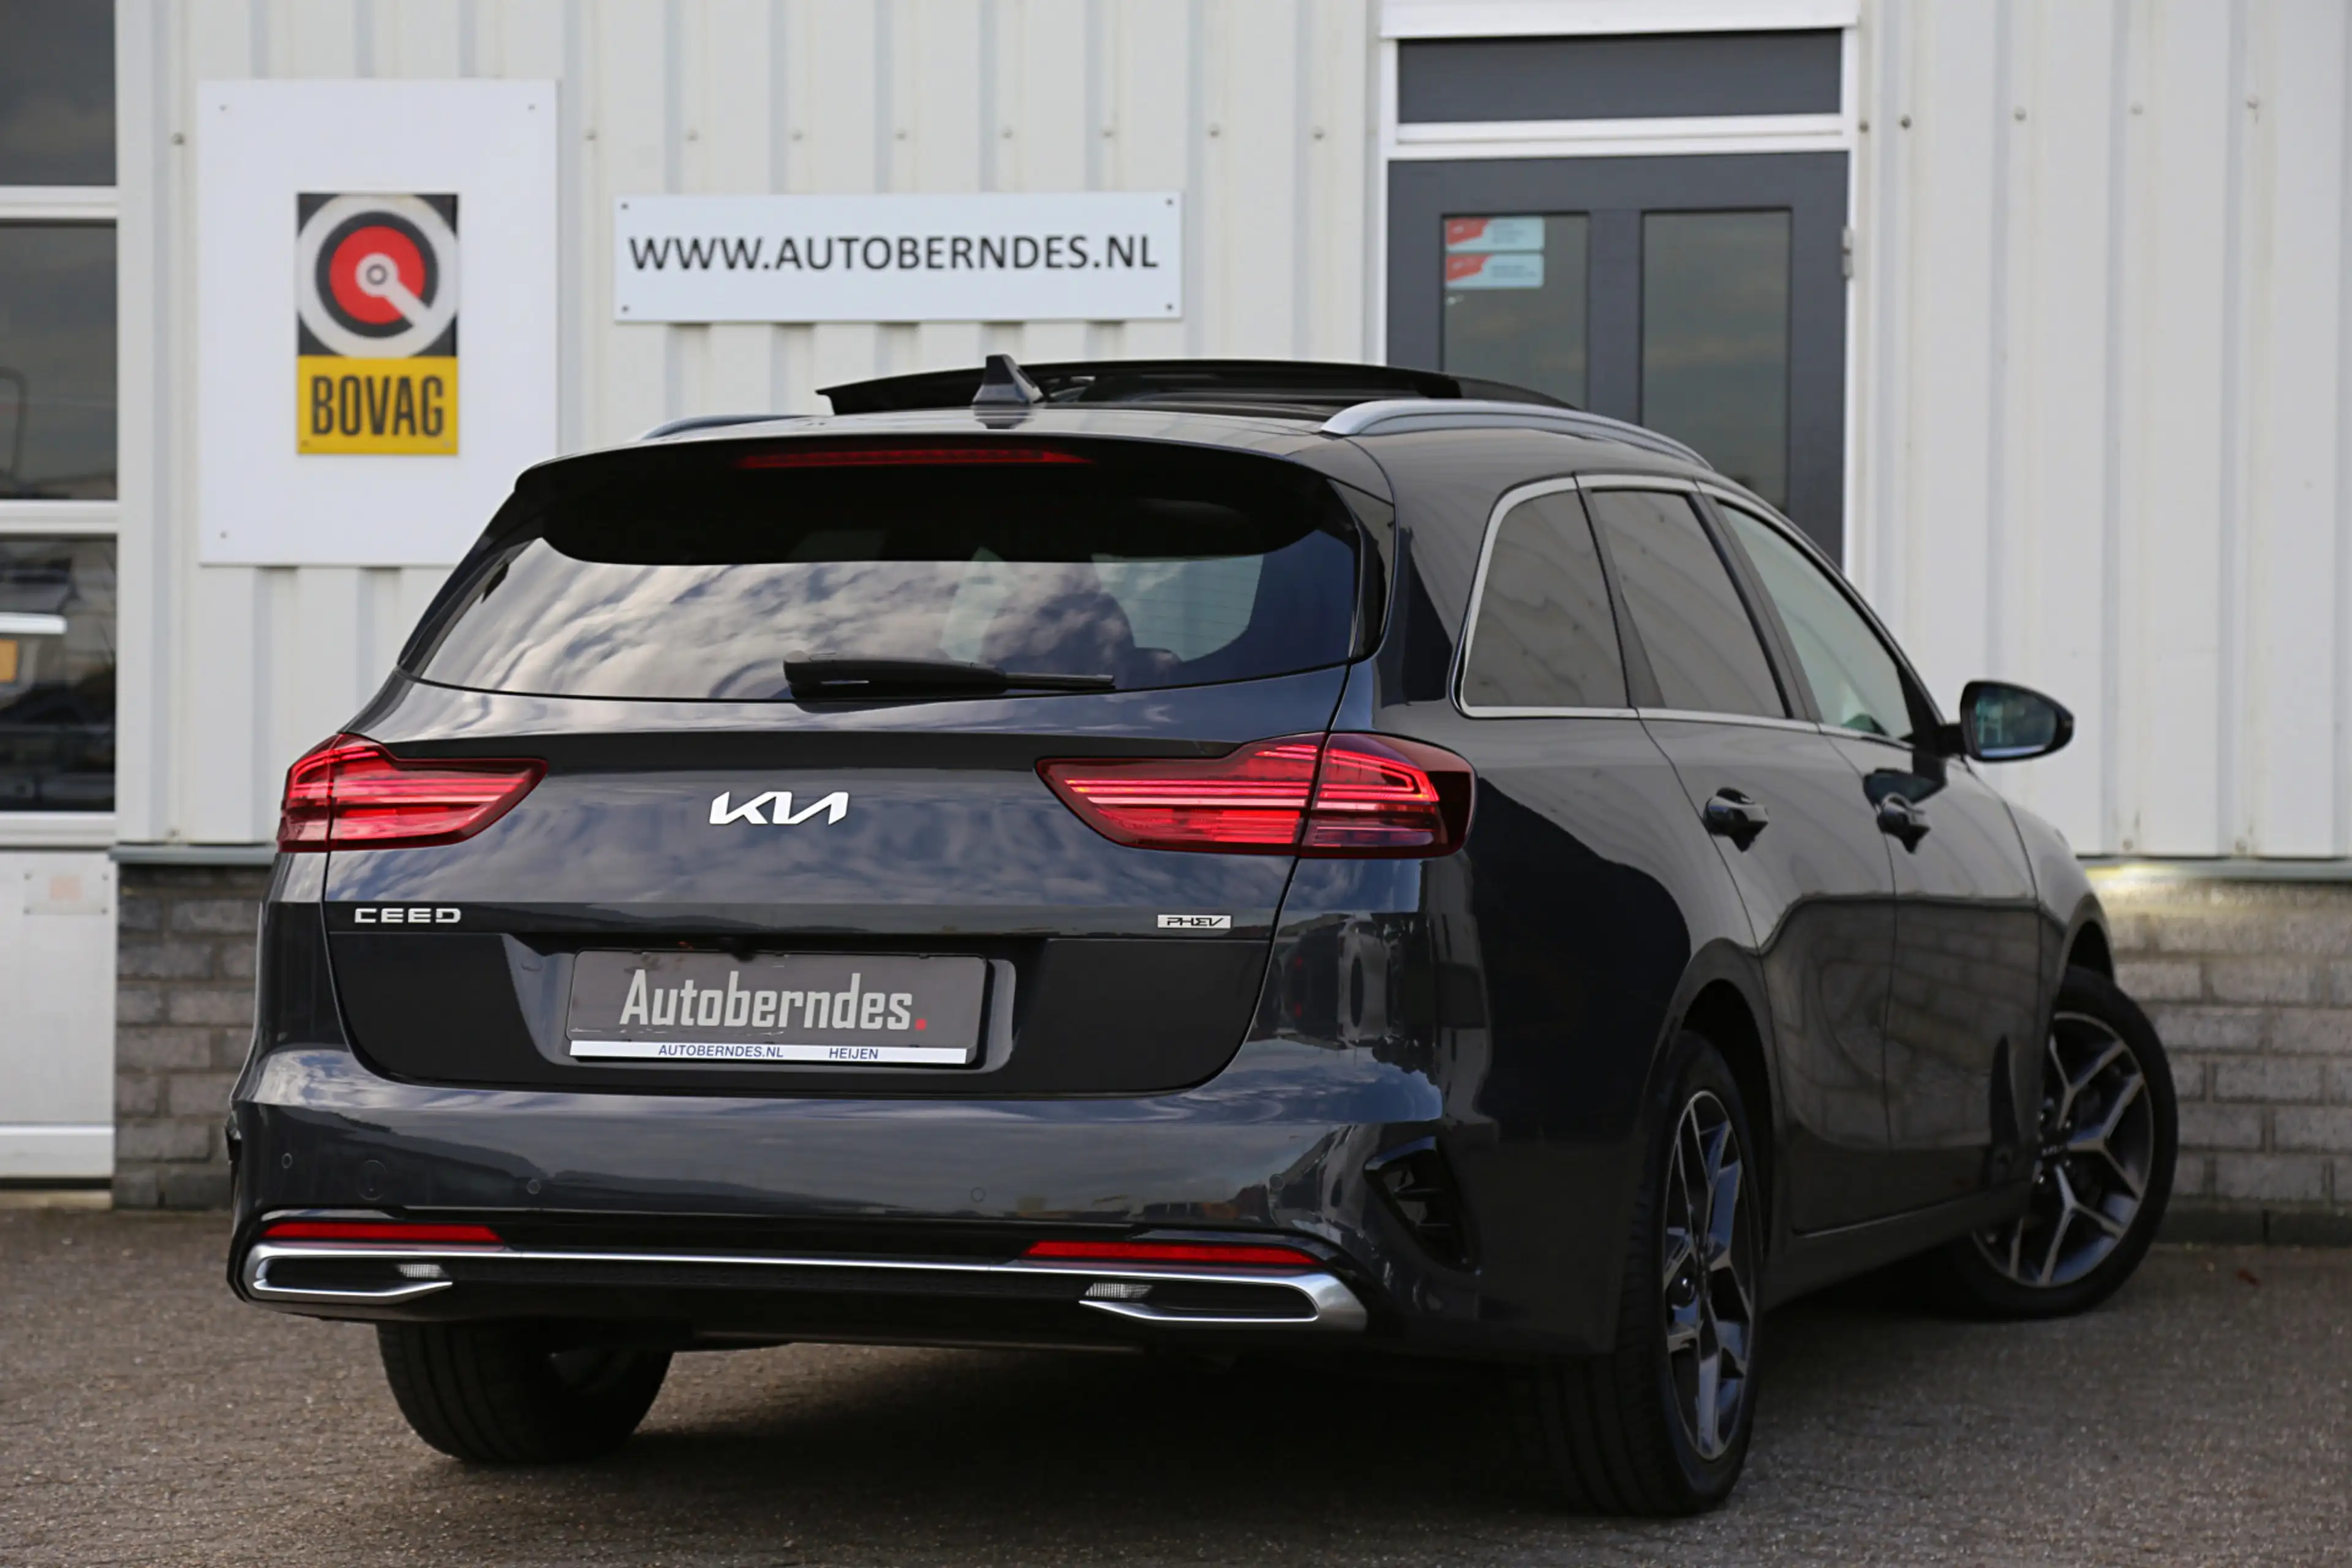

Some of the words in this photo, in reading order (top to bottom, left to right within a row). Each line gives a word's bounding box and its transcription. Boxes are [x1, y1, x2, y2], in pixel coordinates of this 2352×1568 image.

[630, 235, 1159, 271] WWW.AUTOBERNDES.NL
[311, 375, 443, 437] BOVAG
[709, 791, 849, 825] KIA
[354, 908, 461, 923] CEED
[1167, 917, 1224, 927] PHEV
[658, 1045, 784, 1058] AUTOBERNDES.NL
[829, 1047, 879, 1060] HEIJEN
